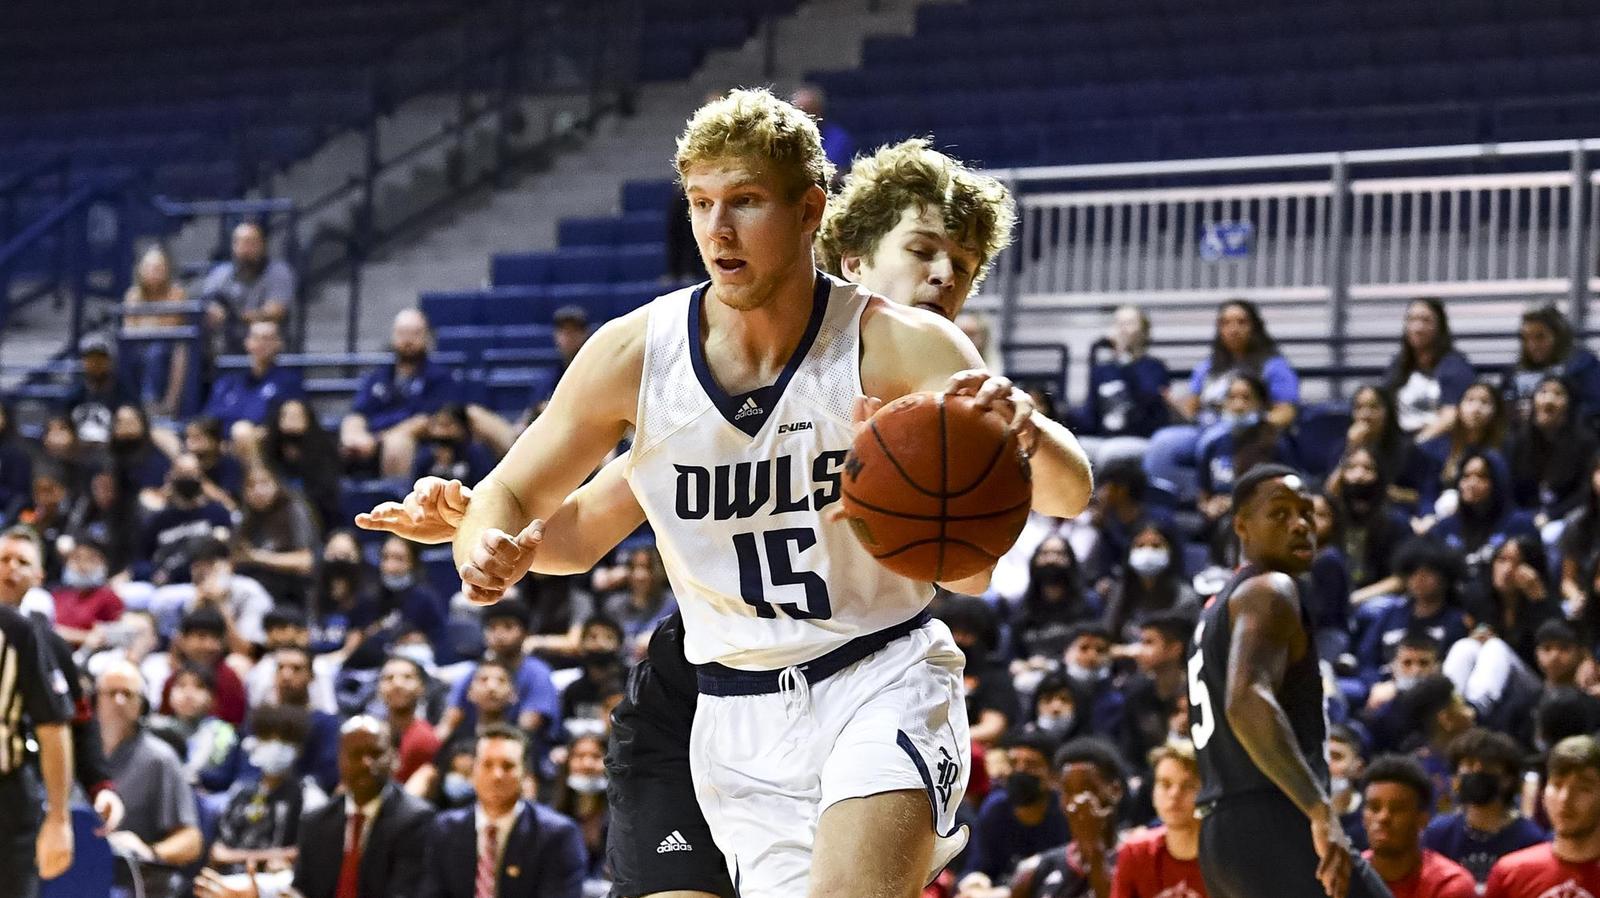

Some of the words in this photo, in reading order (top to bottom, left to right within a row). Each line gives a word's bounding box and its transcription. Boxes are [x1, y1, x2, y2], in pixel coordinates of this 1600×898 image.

[735, 407, 763, 420] adidas
[673, 449, 850, 521] OWLS
[733, 527, 831, 620] 15
[656, 842, 692, 853] adidas
